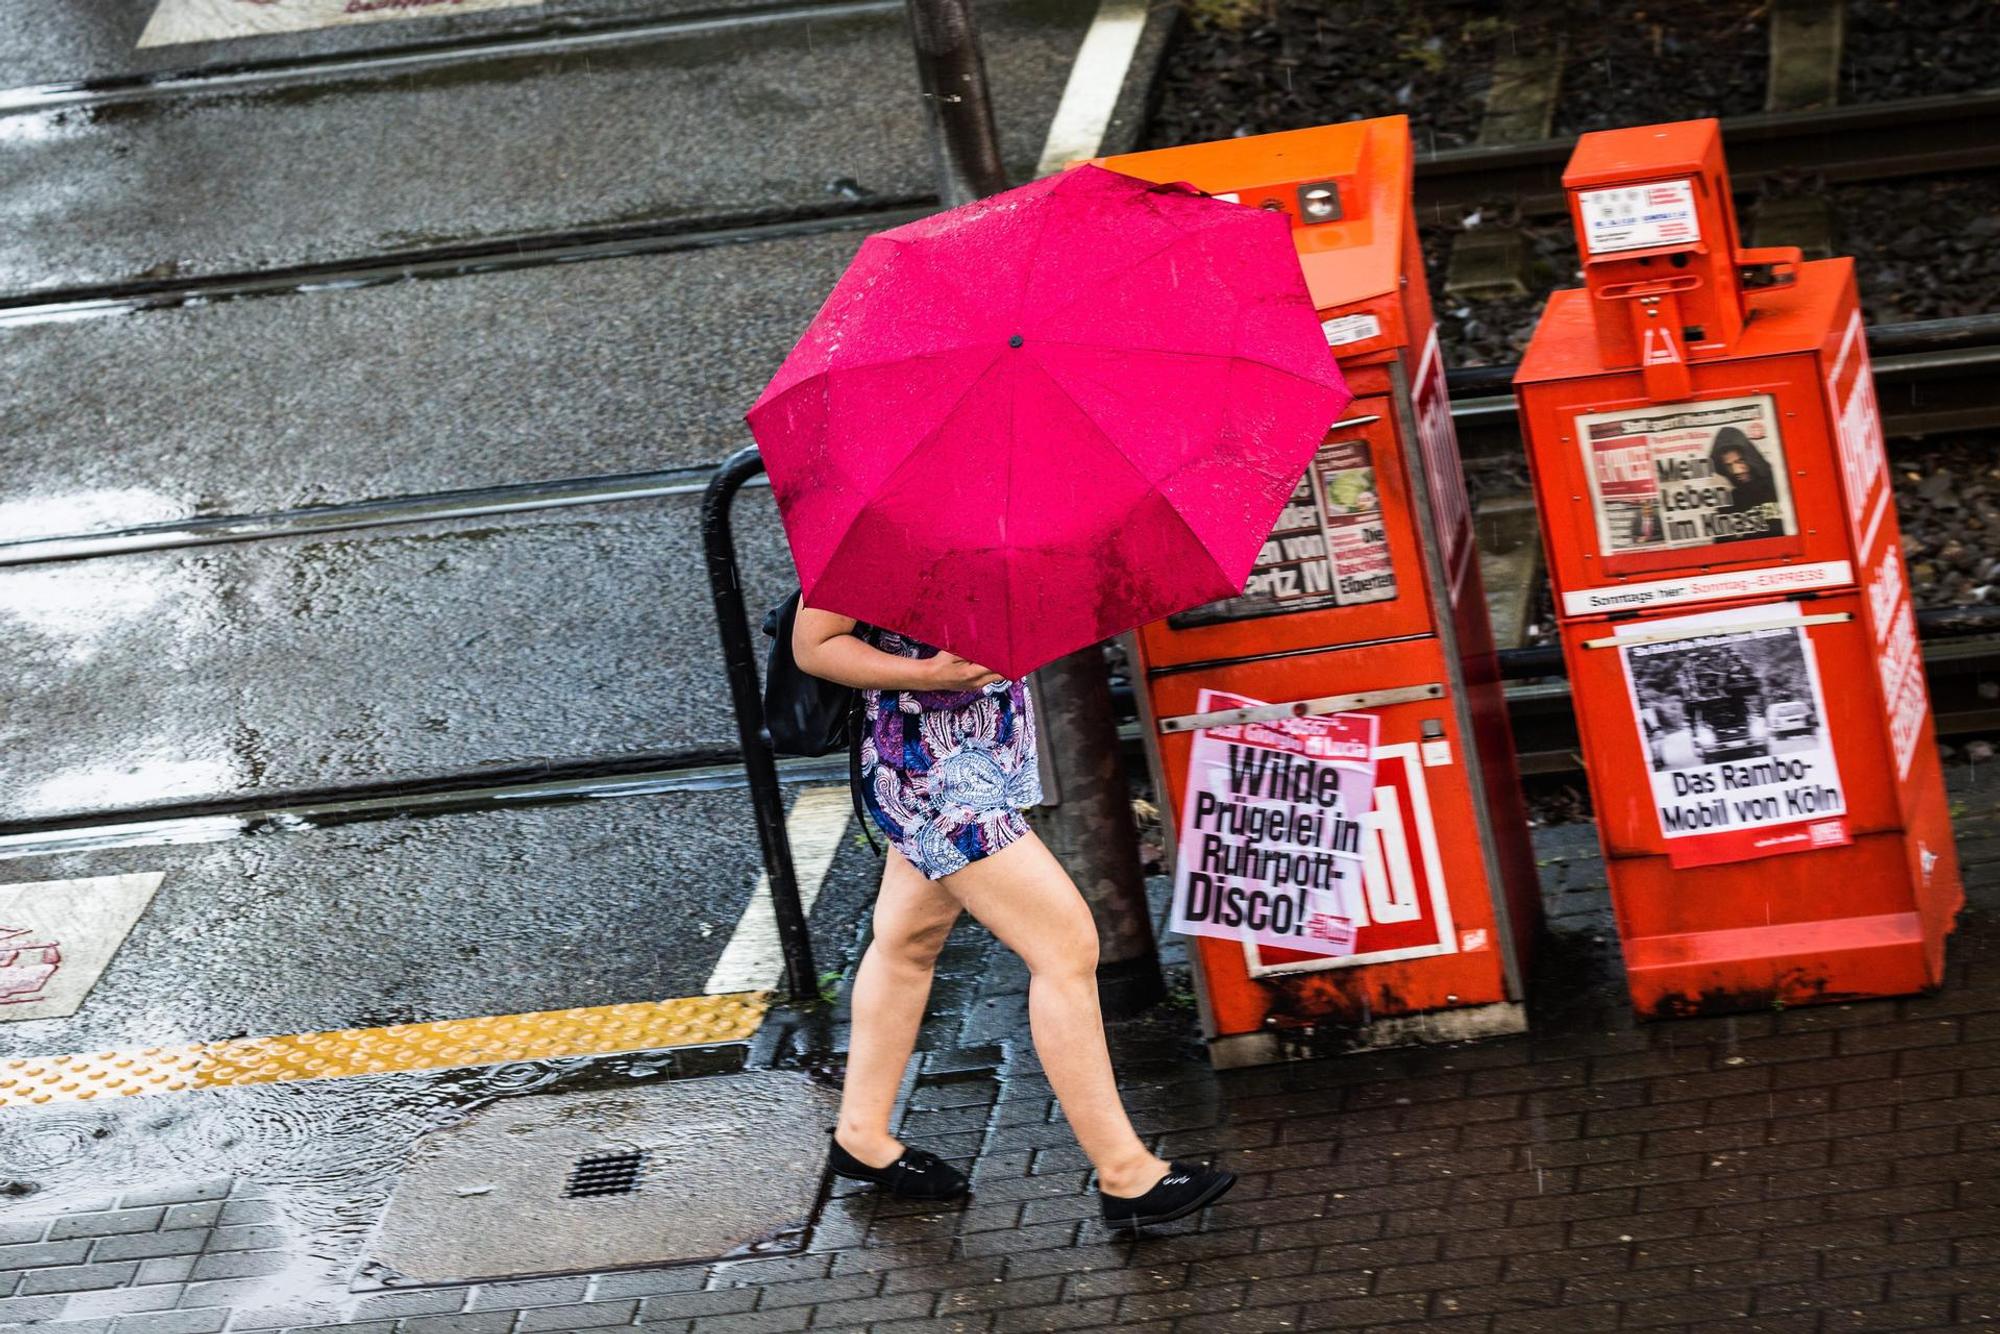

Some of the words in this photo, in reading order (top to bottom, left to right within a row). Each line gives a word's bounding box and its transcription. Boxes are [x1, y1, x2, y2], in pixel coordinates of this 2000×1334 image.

[1656, 453, 1715, 482] Mein
[1662, 485, 1734, 511] Leben
[1242, 568, 1301, 598] artz
[1590, 589, 1654, 607] Sonntags
[1229, 744, 1340, 808] Wilde
[1672, 771, 1716, 797] Das
[1721, 756, 1813, 791] Rambo-
[1193, 790, 1325, 846] Prügelei
[1333, 811, 1361, 853] in
[1662, 798, 1729, 832] Mobil
[1733, 796, 1781, 823] von
[1784, 783, 1840, 816] Köln
[1200, 832, 1345, 891] Ruhrpott-
[1184, 871, 1308, 937] Disco!
